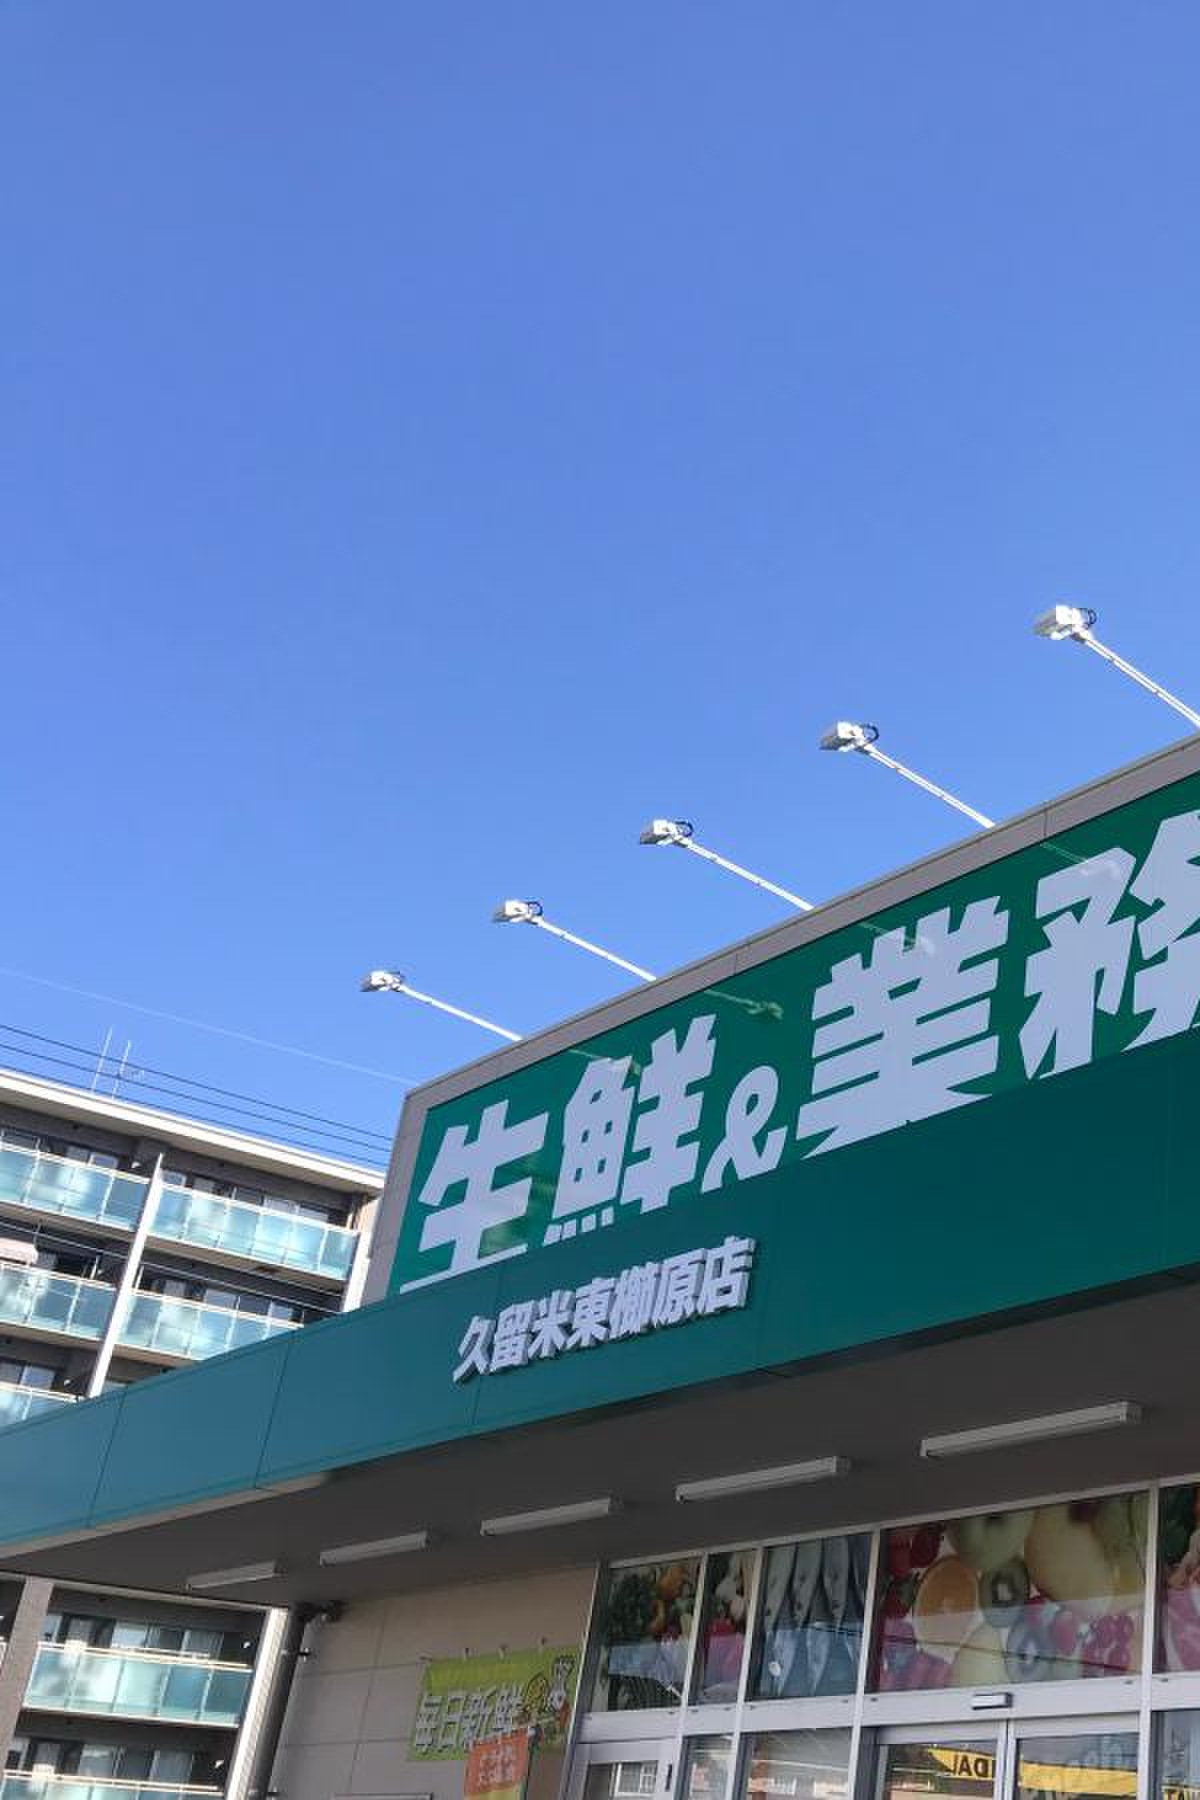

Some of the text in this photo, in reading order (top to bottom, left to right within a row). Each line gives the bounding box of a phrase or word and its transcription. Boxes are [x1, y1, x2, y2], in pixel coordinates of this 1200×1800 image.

[452, 1235, 756, 1382] 久留米東櫛原店
